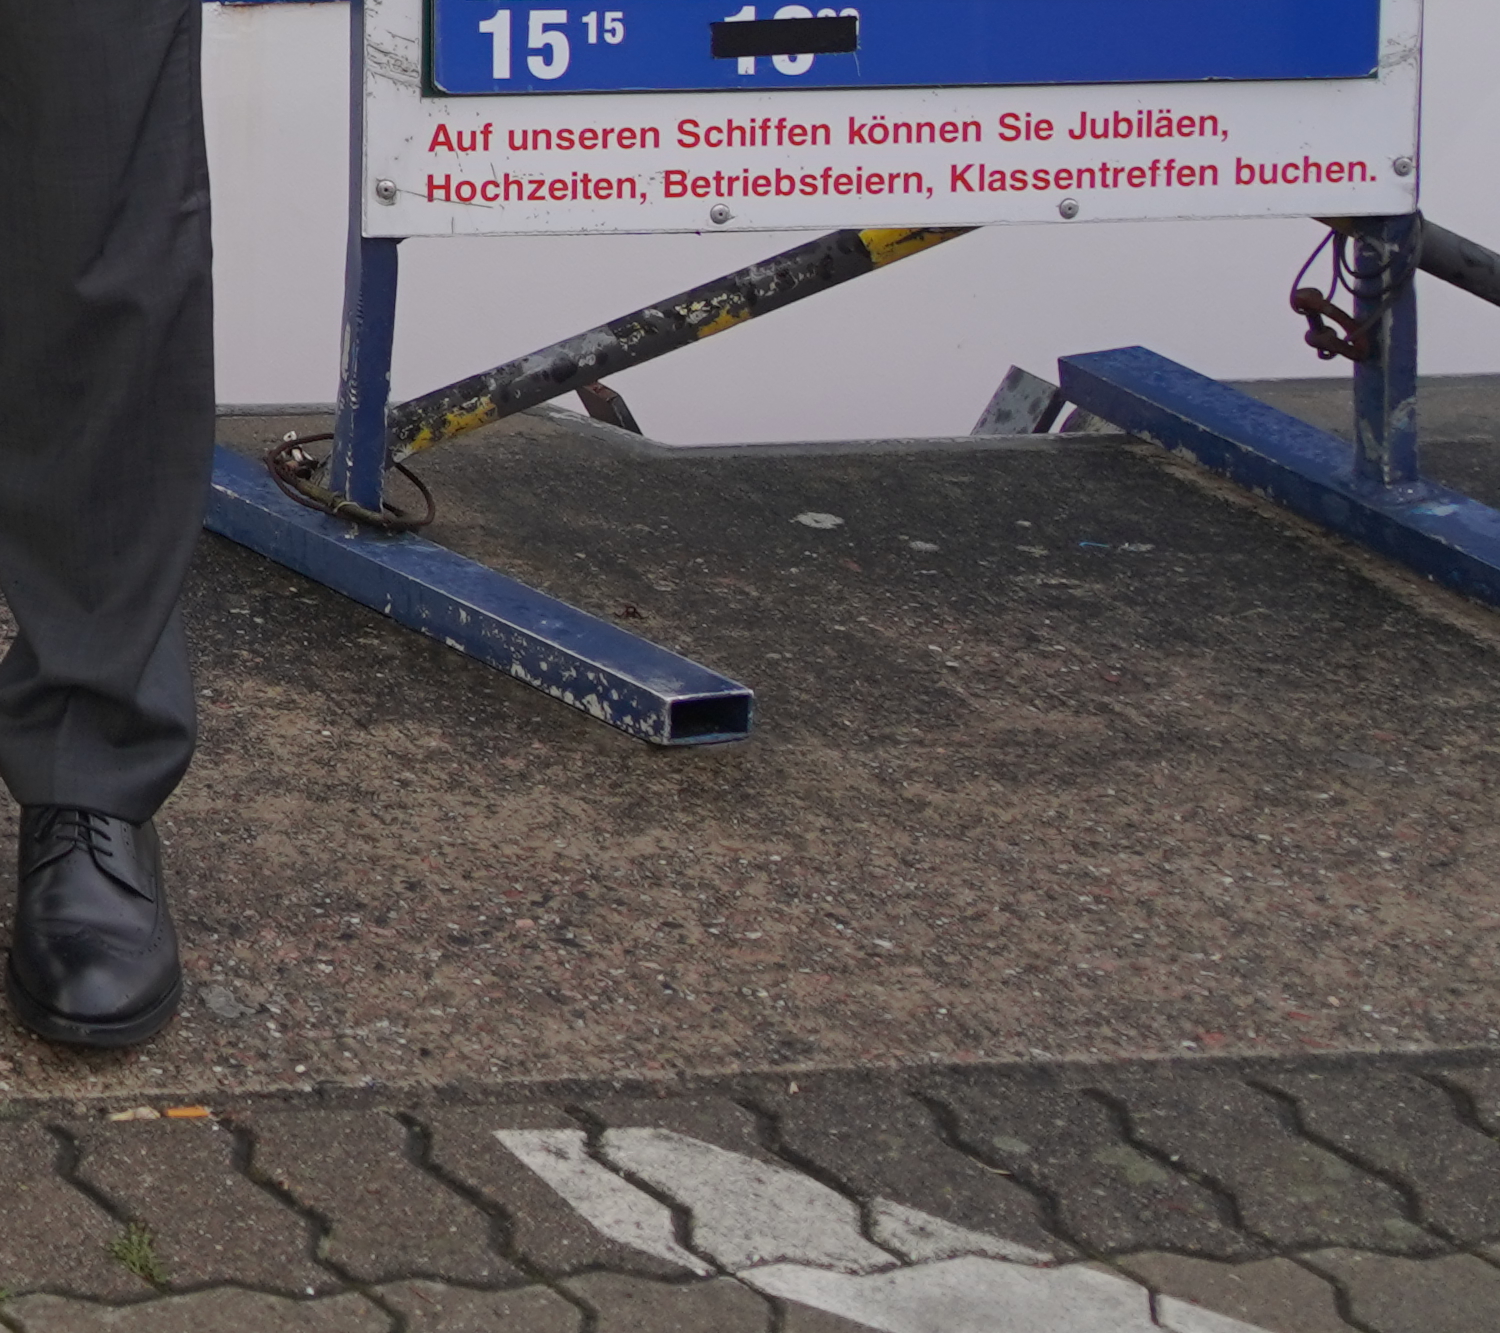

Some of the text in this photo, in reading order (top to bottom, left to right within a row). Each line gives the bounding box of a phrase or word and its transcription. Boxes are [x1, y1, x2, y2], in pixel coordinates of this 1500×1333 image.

[480, 10, 569, 79] 15
[429, 110, 1227, 151] Auf unseren Schiffen können Sie Jubiläen,
[428, 157, 1375, 202] Hochzeiten, Betriebsfeiern, Klassentreffen buchen.
